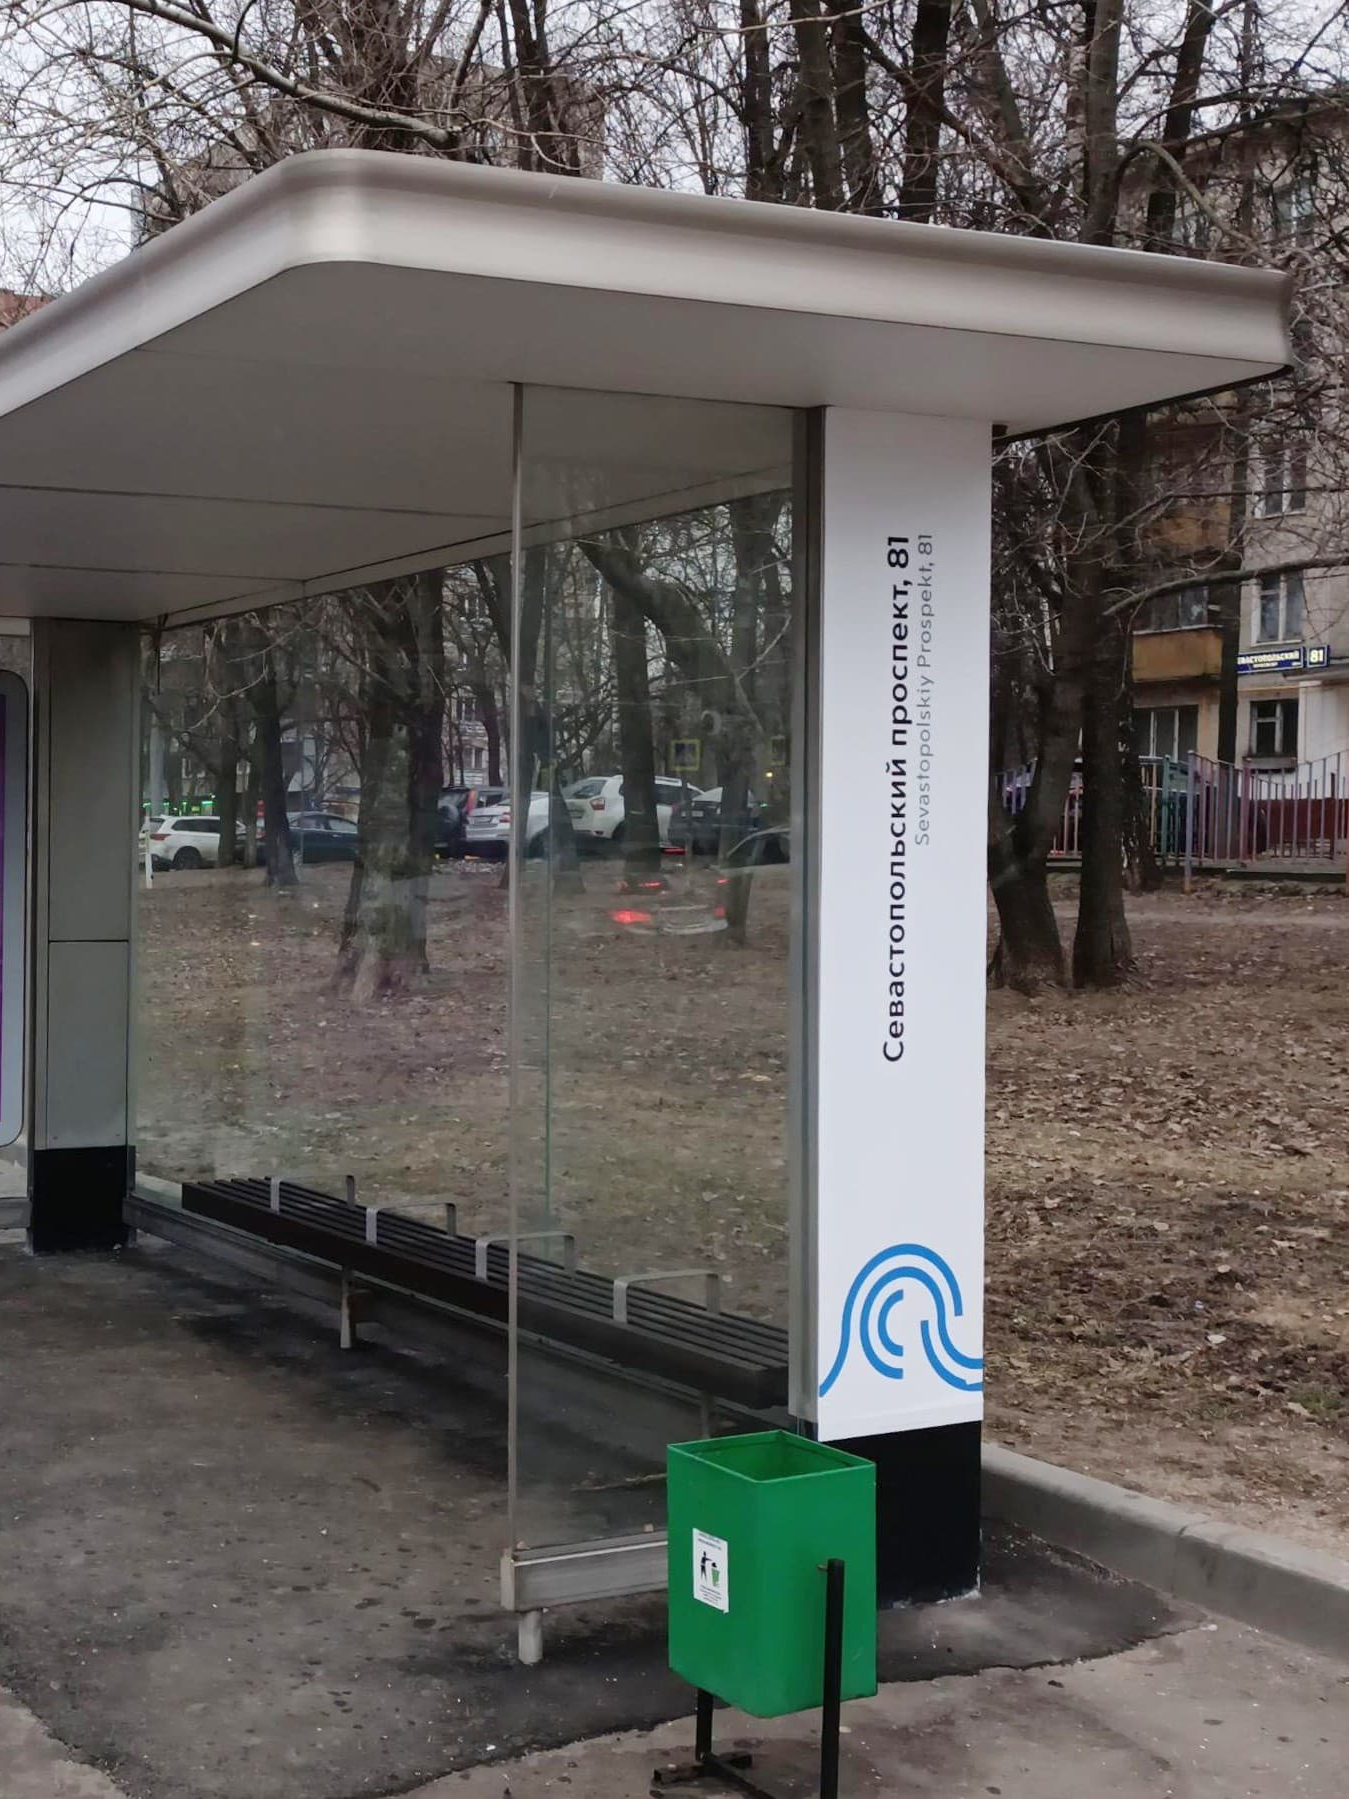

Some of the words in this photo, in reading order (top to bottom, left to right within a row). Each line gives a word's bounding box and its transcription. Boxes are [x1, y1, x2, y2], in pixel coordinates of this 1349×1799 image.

[887, 536, 910, 569] 81
[917, 534, 933, 556] 81
[891, 579, 913, 746] проспект,
[916, 562, 935, 668] Prospekt,
[1310, 649, 1324, 662] 81
[915, 675, 935, 846] Sevastopolskiy
[883, 758, 907, 1062] Севастопольский
